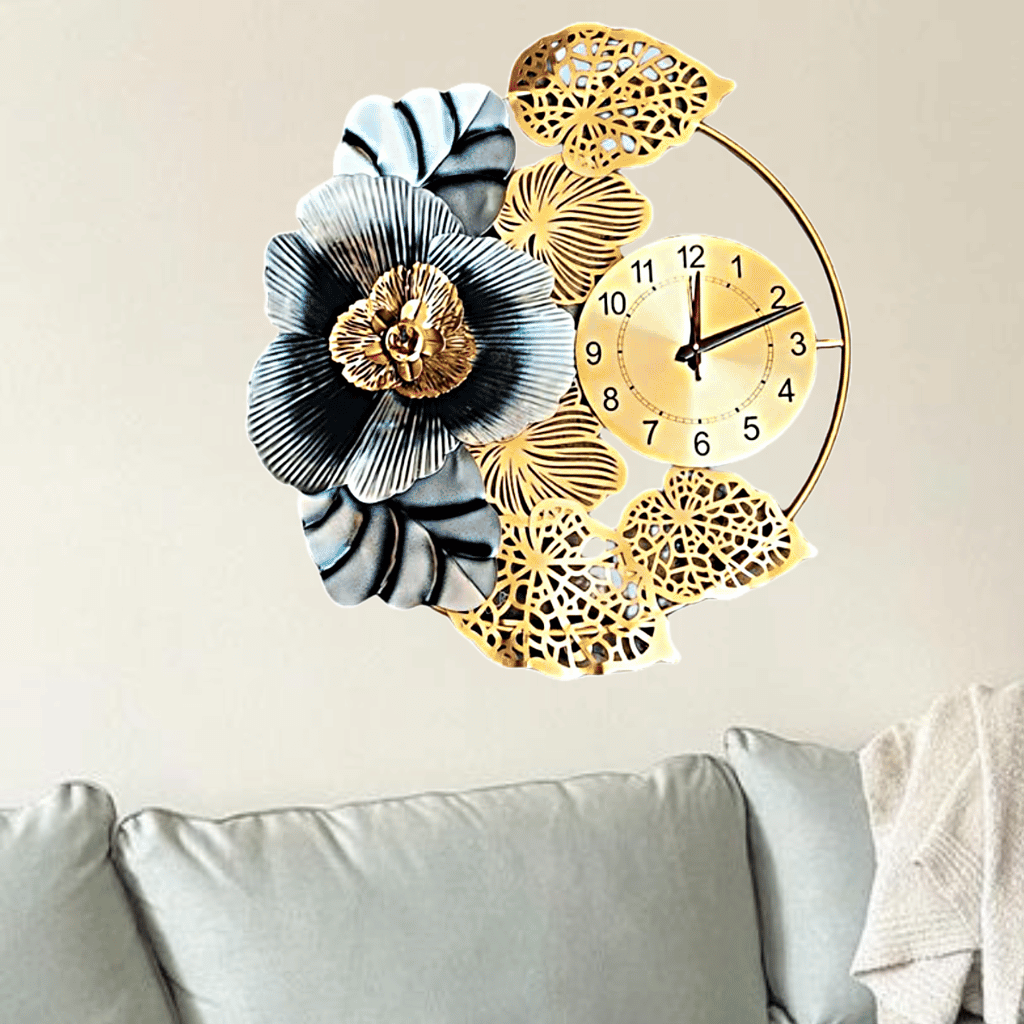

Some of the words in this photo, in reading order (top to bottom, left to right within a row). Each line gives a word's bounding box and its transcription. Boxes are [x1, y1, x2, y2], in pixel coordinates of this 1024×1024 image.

[677, 244, 706, 269] 12
[731, 254, 742, 279] 1
[631, 259, 654, 284] 11
[598, 290, 627, 316] 10
[769, 285, 787, 310] 2
[585, 341, 602, 366] 9
[790, 331, 807, 357] 3
[603, 386, 619, 412] 8
[777, 377, 795, 403] 4
[642, 419, 659, 446] 7
[743, 415, 760, 441] 5
[694, 431, 711, 457] 6
